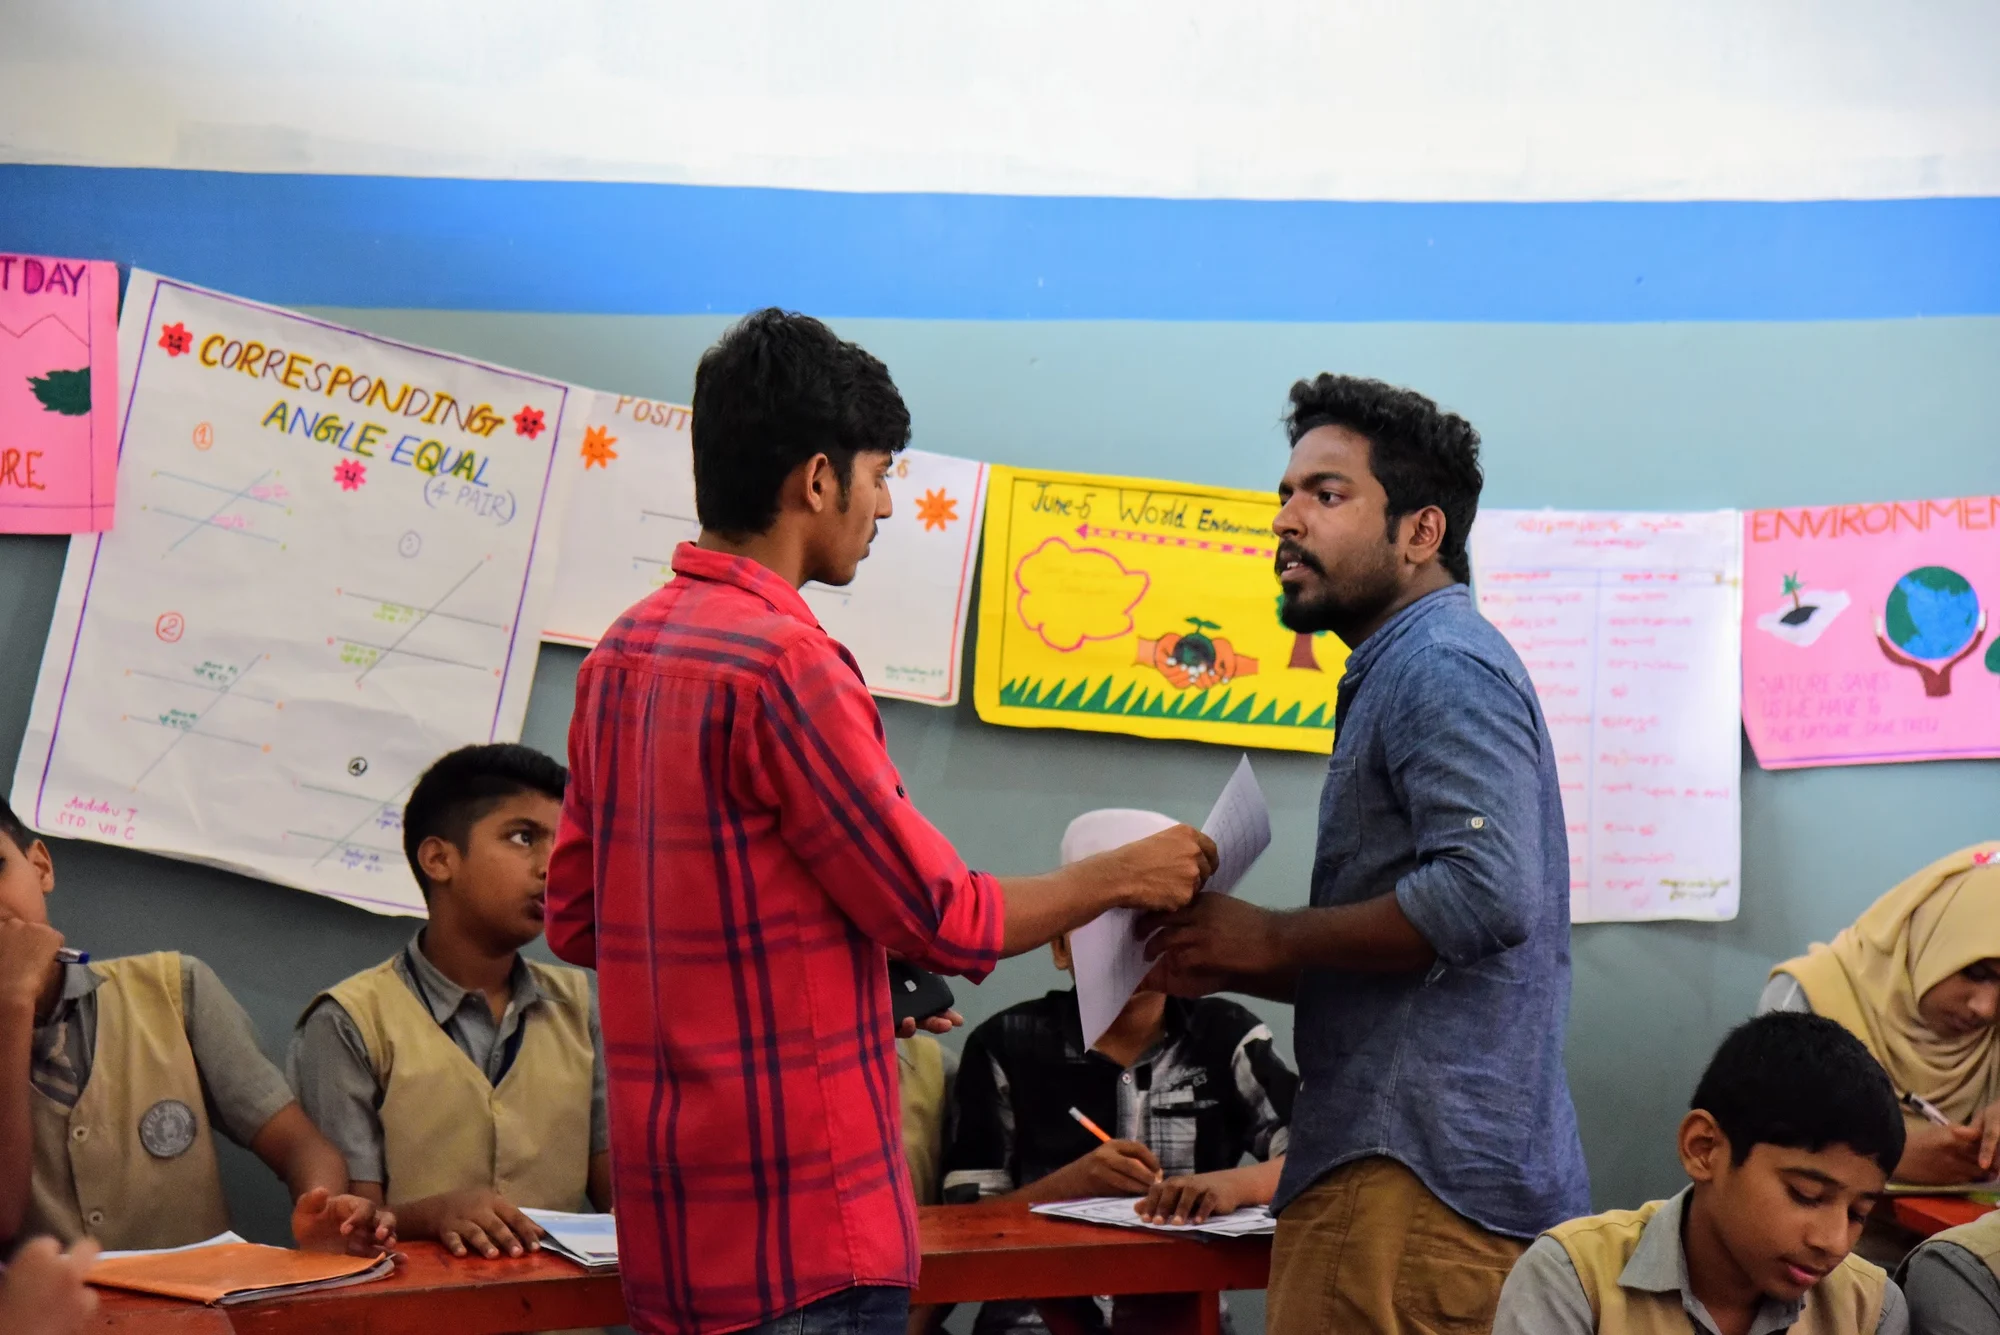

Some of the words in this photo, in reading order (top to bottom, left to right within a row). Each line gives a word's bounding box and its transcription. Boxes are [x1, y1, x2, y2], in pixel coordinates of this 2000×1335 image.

[23, 258, 86, 297] DAY
[199, 335, 504, 436] CORRESPONDING
[262, 400, 386, 457] ANGLE
[391, 435, 488, 487] EQUAL
[0, 448, 45, 490] RE
[455, 484, 515, 525] PAIR)
[1119, 488, 1187, 528] World
[124, 826, 135, 840] C
